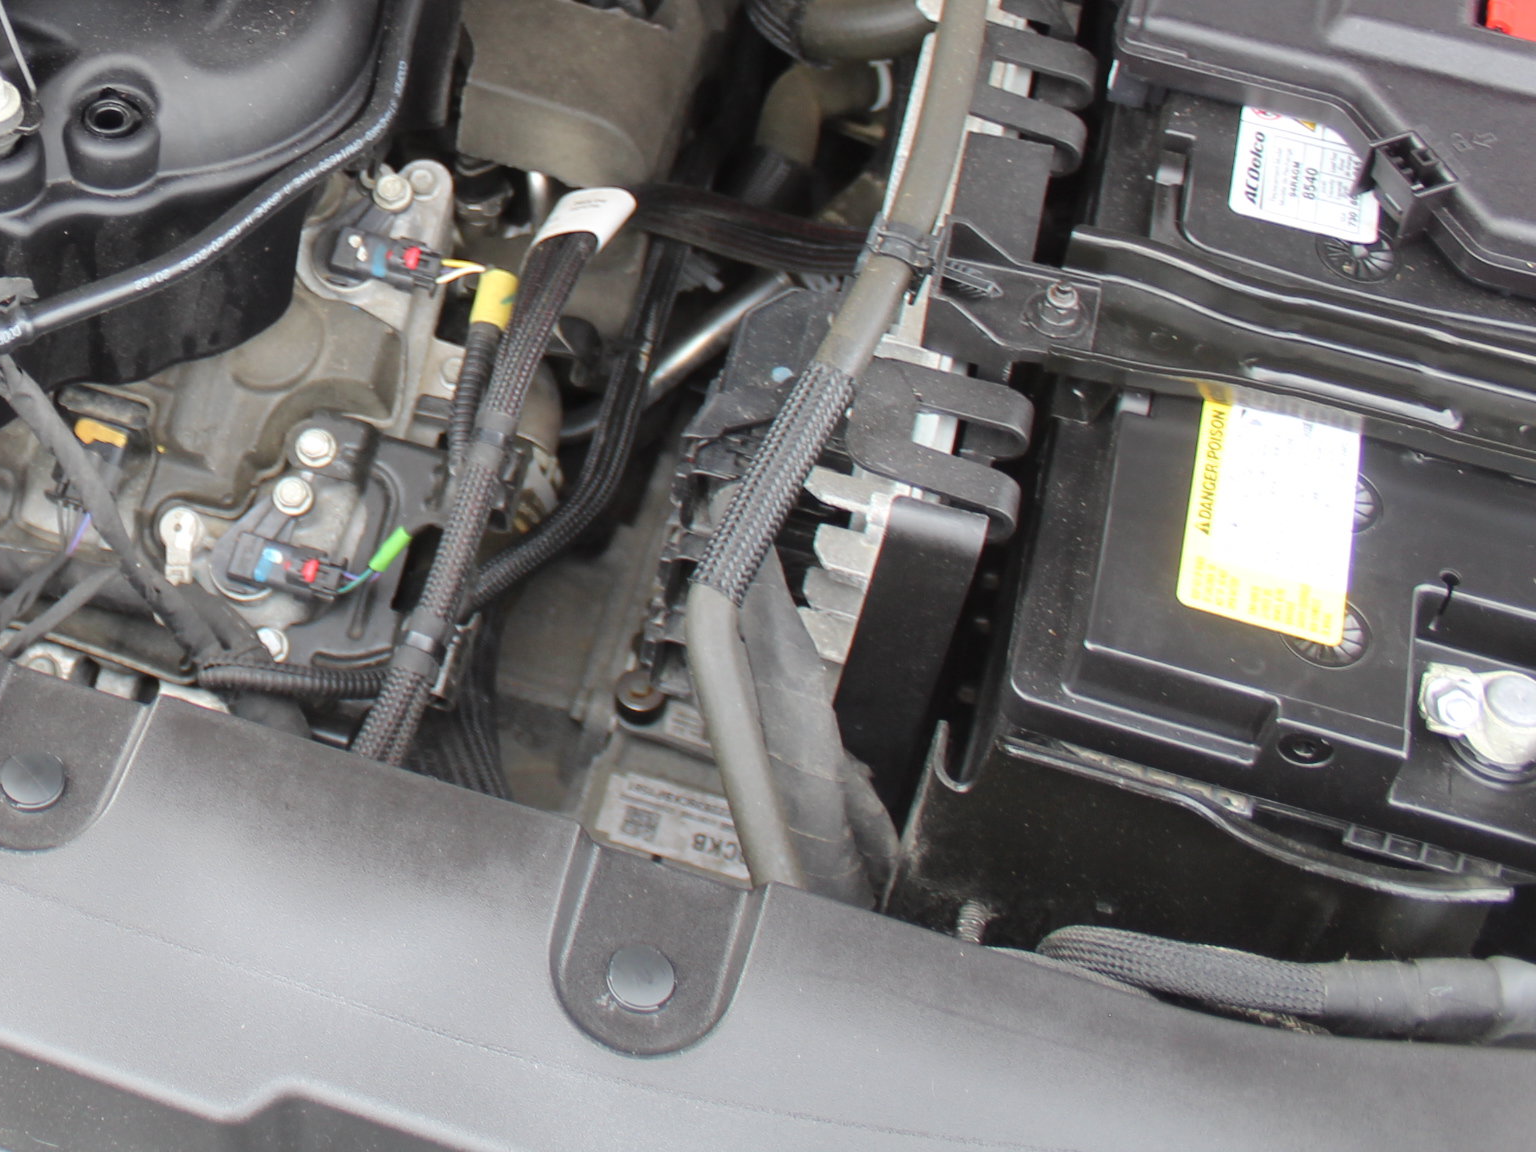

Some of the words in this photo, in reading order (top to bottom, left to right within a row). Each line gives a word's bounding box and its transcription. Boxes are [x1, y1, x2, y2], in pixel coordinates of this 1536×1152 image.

[1244, 131, 1265, 205] ACDelco
[1207, 410, 1226, 460] POISON
[1199, 463, 1219, 519] DANGER
[693, 833, 745, 863] CKB
